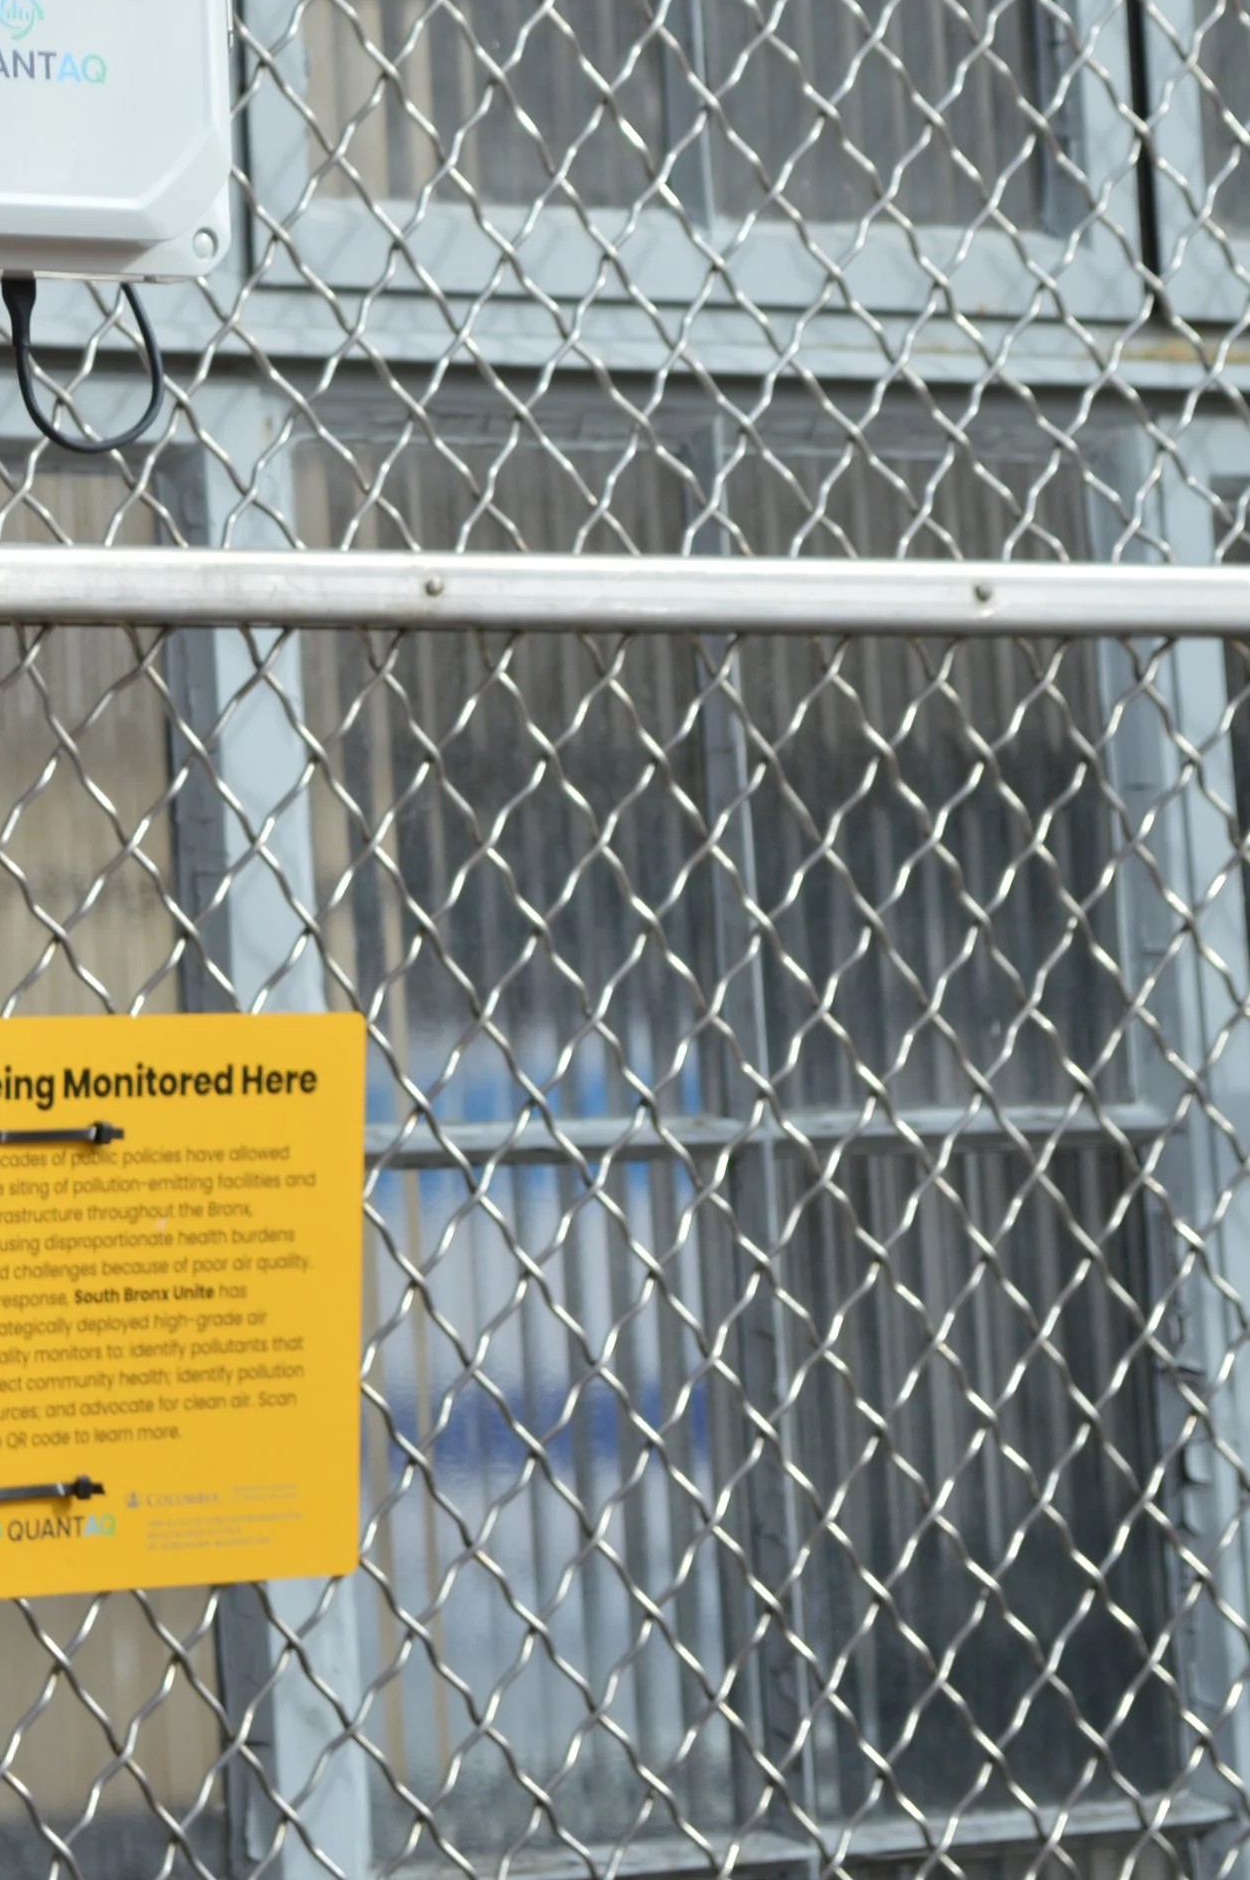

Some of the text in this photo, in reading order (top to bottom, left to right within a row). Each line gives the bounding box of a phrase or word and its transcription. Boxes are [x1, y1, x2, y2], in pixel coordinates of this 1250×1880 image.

[62, 1063, 233, 1099] Monitored
[242, 1064, 317, 1095] Here
[52, 1149, 66, 1166] of
[71, 1148, 118, 1169] public
[123, 1146, 181, 1168] policies
[187, 1146, 225, 1162] have
[229, 1145, 291, 1161] allowed
[9, 1179, 50, 1200] siting
[54, 1178, 69, 1195] of
[73, 1173, 213, 1198] pollution-emitting
[218, 1172, 281, 1189] facilities
[285, 1171, 316, 1188] and
[87, 1203, 174, 1225] throughout
[178, 1202, 203, 1218] the
[208, 1201, 253, 1218] Bronx,
[44, 1231, 174, 1255] disproportionate
[177, 1229, 227, 1246] health
[231, 1227, 296, 1244] burdens
[13, 1261, 98, 1283] challenges
[102, 1259, 169, 1275] because
[173, 1257, 188, 1273] of
[192, 1259, 228, 1277] poor
[232, 1255, 252, 1271] air
[74, 1288, 120, 1304] South
[124, 1286, 169, 1302] Bronx
[173, 1284, 215, 1301] Unite
[219, 1284, 248, 1300] has
[77, 1315, 149, 1336] deployed
[153, 1311, 243, 1334] high-grade
[247, 1310, 267, 1326] air
[34, 1345, 102, 1363] monitors
[130, 1339, 185, 1361] identify
[191, 1337, 268, 1359] pollutants
[272, 1335, 304, 1352] that
[26, 1372, 114, 1393] community
[177, 1365, 232, 1386] identify
[237, 1363, 304, 1385] pollution
[45, 1401, 76, 1418] and
[80, 1398, 154, 1416] advocate
[158, 1395, 179, 1412] for
[183, 1393, 227, 1411] clean
[258, 1390, 297, 1408] Scan
[6, 1431, 28, 1449] QR
[32, 1428, 70, 1447] code
[75, 1429, 91, 1445] to
[94, 1426, 134, 1443] learn
[137, 1424, 182, 1441] more.
[7, 1513, 117, 1541] QUANTAQ
